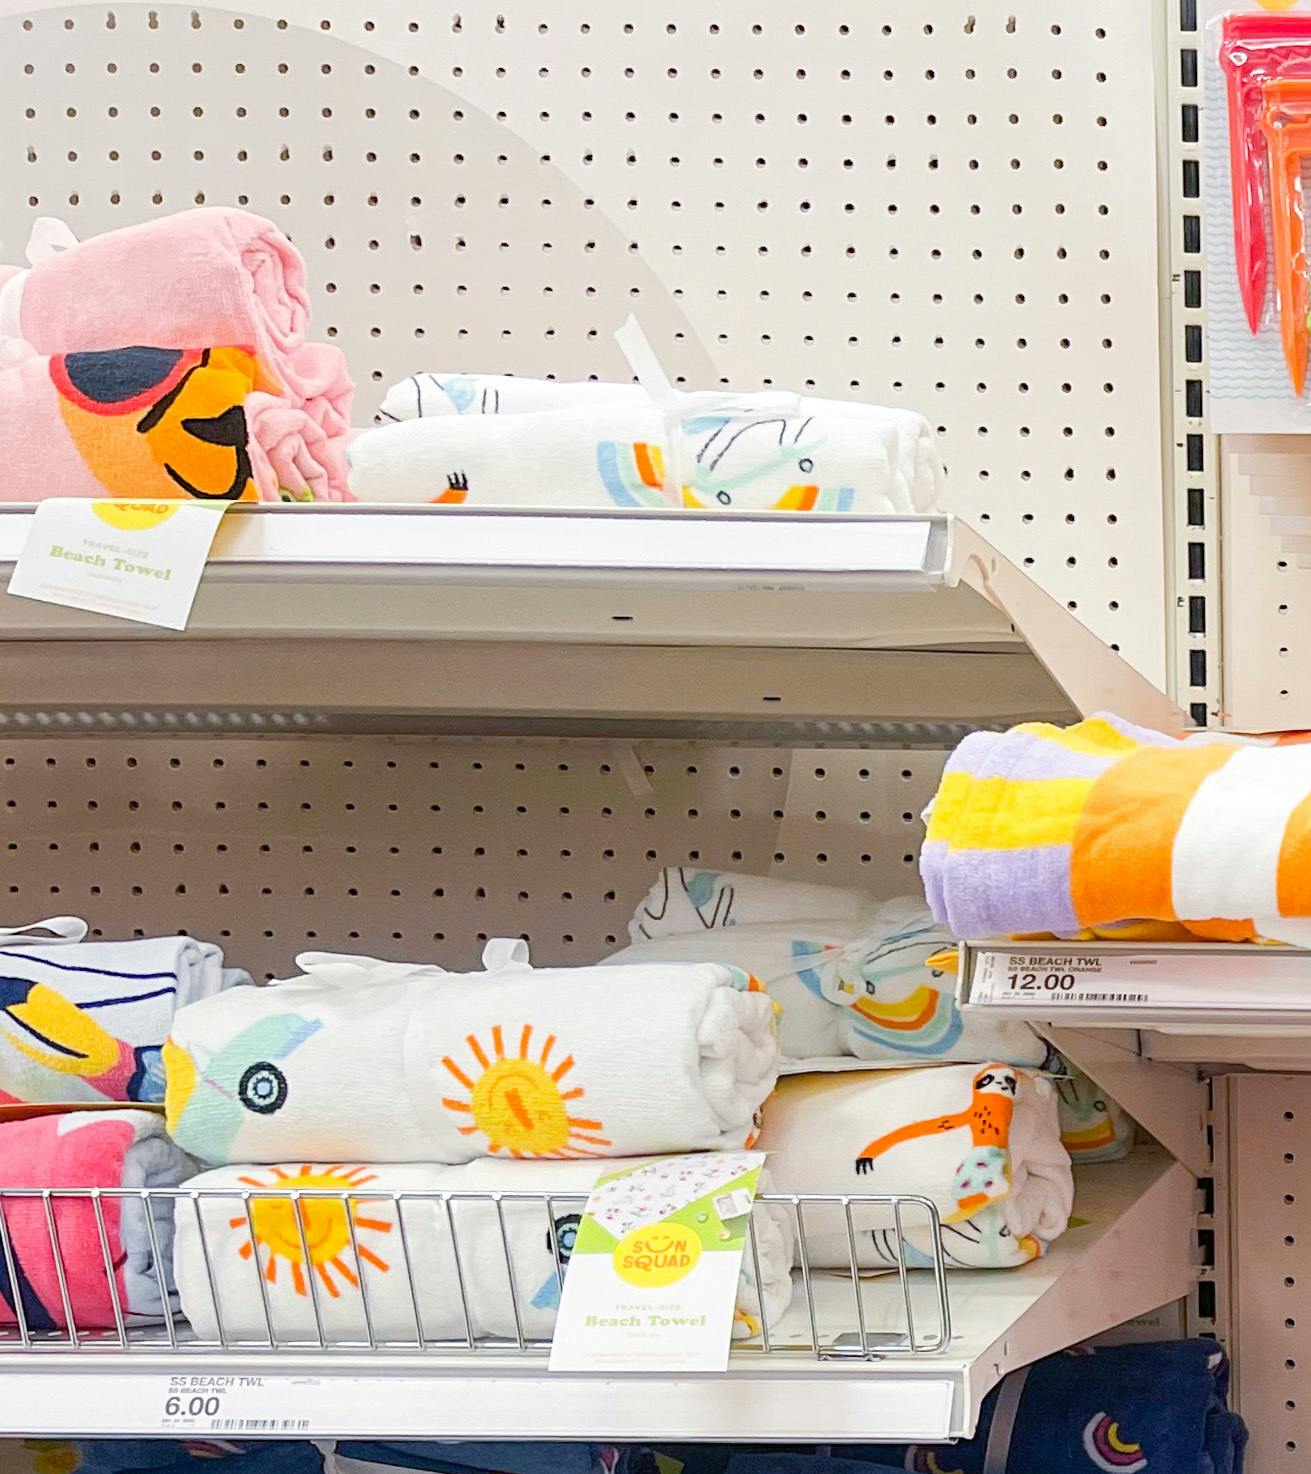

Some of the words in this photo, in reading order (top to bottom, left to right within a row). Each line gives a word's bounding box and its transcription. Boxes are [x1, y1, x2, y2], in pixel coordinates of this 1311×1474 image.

[50, 544, 106, 568] Beach
[113, 558, 172, 581] Towel
[1009, 956, 1026, 966] SS
[1029, 956, 1073, 966] BEACH
[1076, 956, 1103, 966] TWL
[1008, 973, 1075, 991] 12.00
[632, 1237, 687, 1254] SUN
[622, 1253, 690, 1272] SQUAD
[584, 1315, 641, 1327] Beach
[648, 1314, 707, 1327] Towel
[170, 1376, 187, 1387] SS
[190, 1376, 235, 1387] BEACH
[238, 1376, 265, 1387] TWL
[165, 1396, 220, 1416] 6.00
